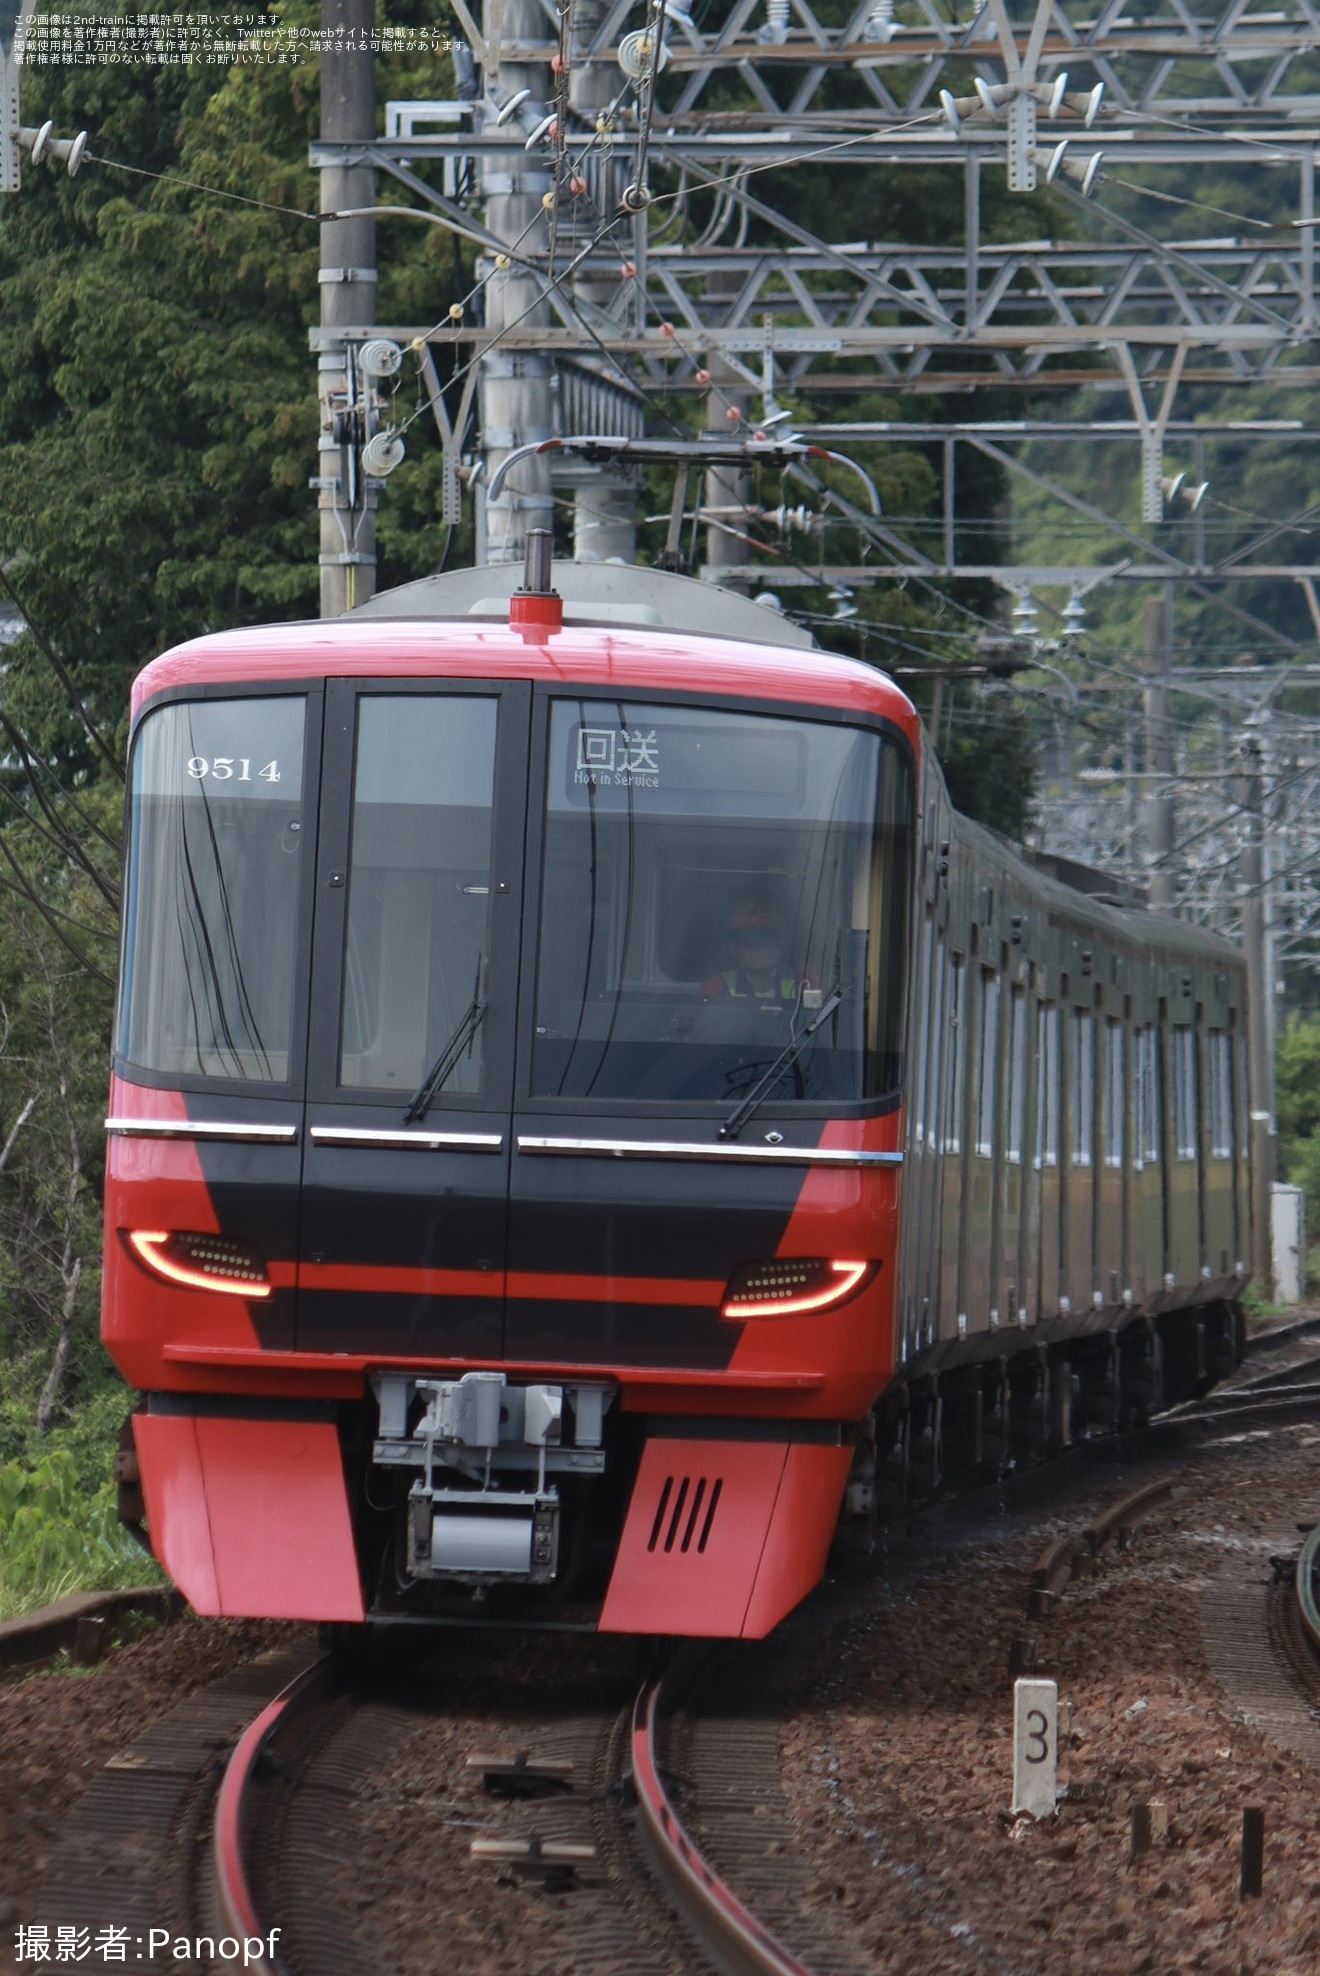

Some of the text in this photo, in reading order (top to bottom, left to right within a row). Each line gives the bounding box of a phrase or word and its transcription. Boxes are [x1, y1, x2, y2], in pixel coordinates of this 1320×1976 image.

[576, 728, 660, 773] 回送
[187, 756, 281, 782] 9514
[574, 770, 660, 788] Not in Service
[1025, 1709, 1049, 1764] 3
